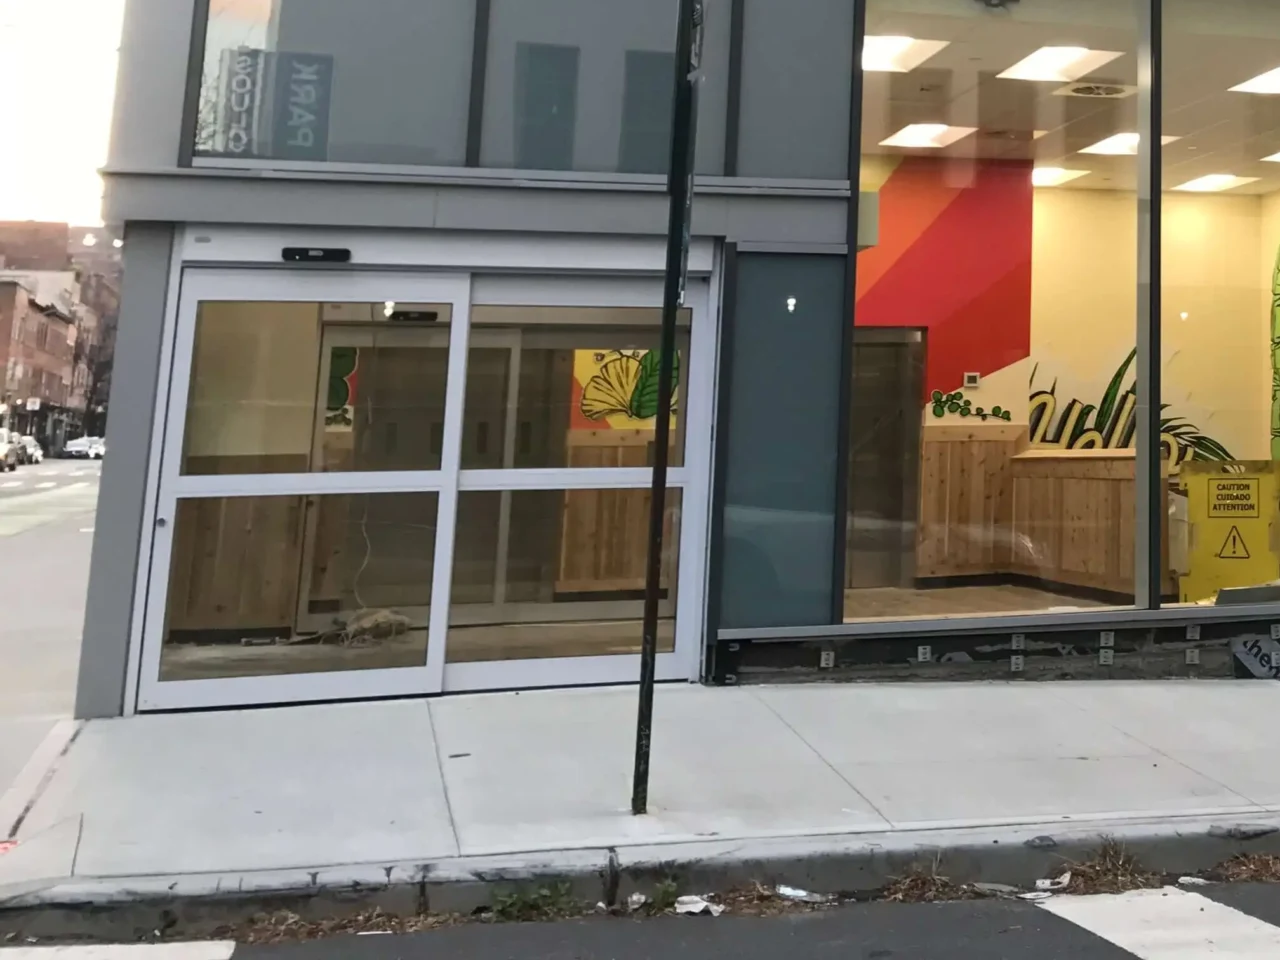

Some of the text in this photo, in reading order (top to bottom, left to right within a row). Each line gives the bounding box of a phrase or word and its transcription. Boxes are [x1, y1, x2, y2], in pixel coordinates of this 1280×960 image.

[1216, 483, 1250, 491] CAUTION
[1216, 493, 1251, 501] CUIDADO
[1212, 503, 1255, 511] ATTENTION
